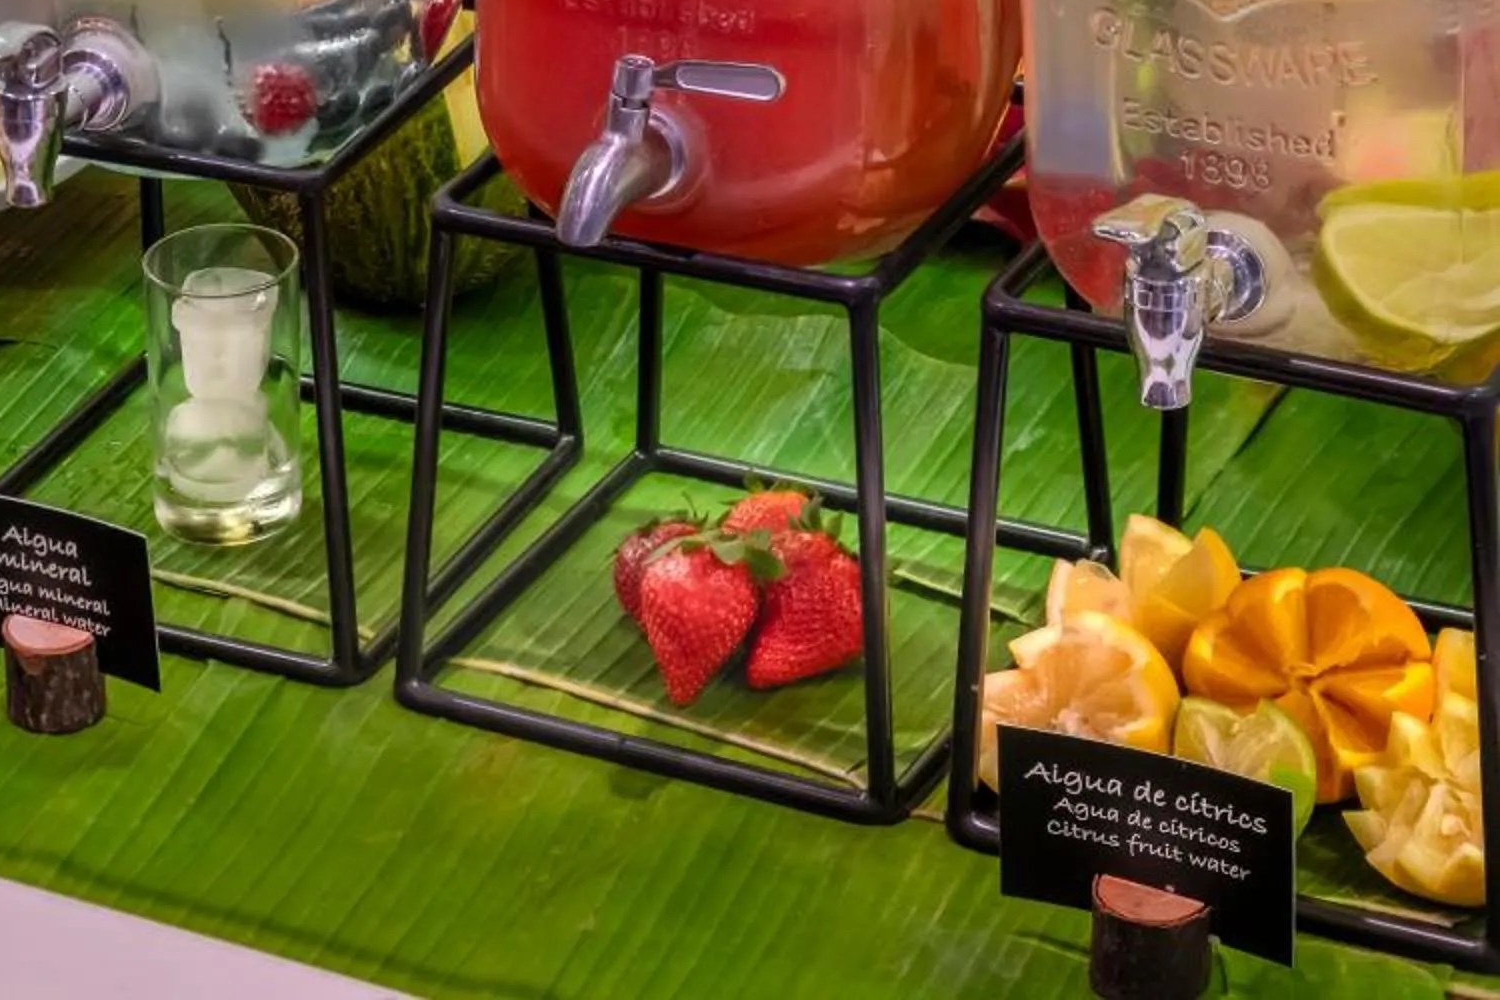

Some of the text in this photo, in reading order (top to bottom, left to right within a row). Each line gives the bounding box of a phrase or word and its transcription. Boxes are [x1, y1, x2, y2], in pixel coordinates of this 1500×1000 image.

[1088, 5, 1379, 90] GLASSWARE
[1122, 97, 1336, 161] Established
[1, 525, 78, 559] Aigua
[38, 585, 111, 616] mineral
[62, 614, 112, 637] water
[1023, 761, 1269, 834] Aigua de cítrics
[1053, 796, 1120, 823] Agua
[1127, 809, 1153, 830] de
[1046, 819, 1252, 881] Citrus fruit water
